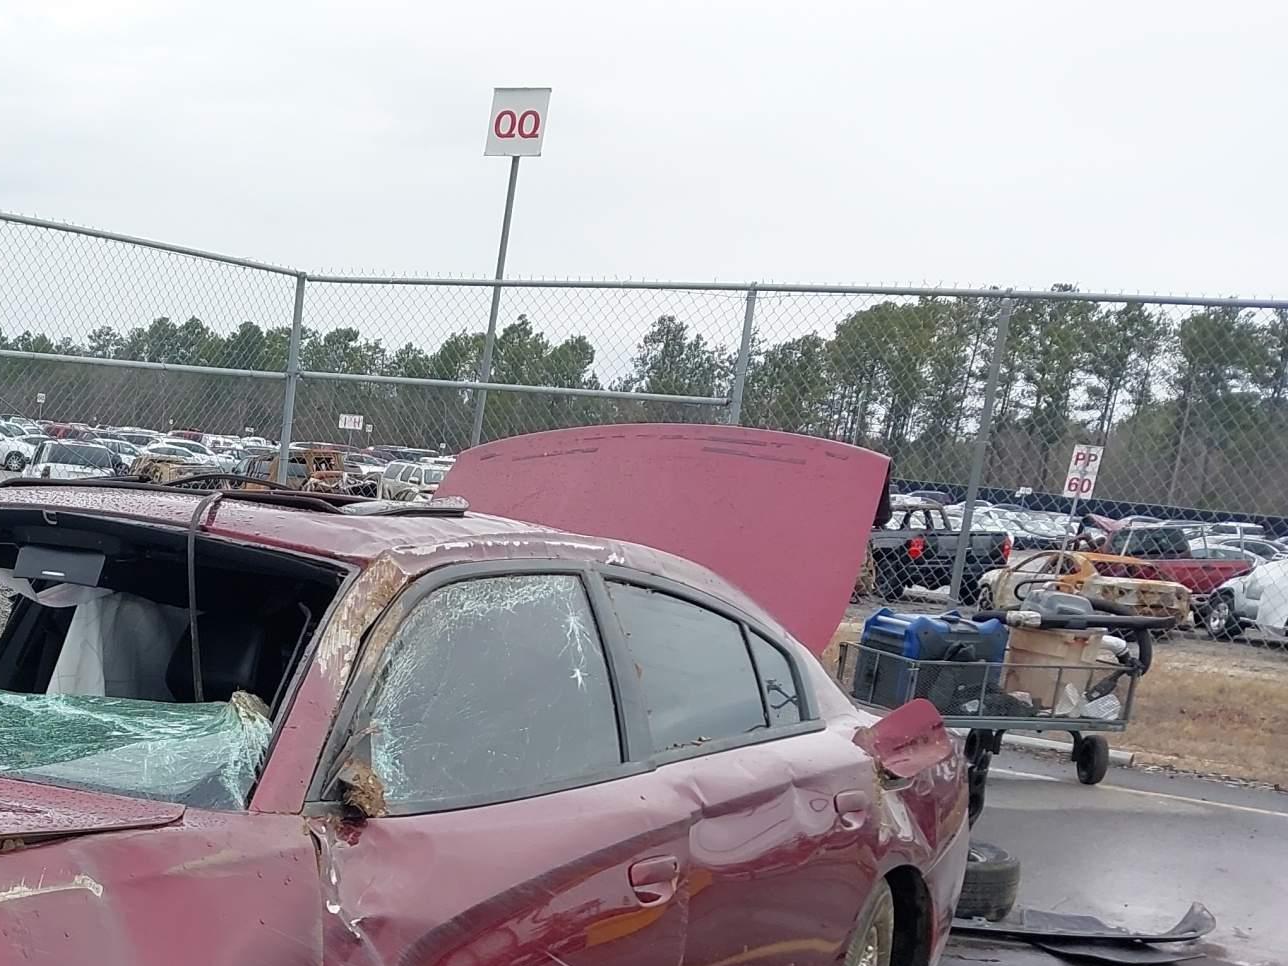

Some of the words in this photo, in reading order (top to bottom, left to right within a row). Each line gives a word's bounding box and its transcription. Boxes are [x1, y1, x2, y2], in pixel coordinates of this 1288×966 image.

[494, 109, 541, 139] QQ
[1073, 452, 1098, 467] PP
[1067, 477, 1092, 493] 60
